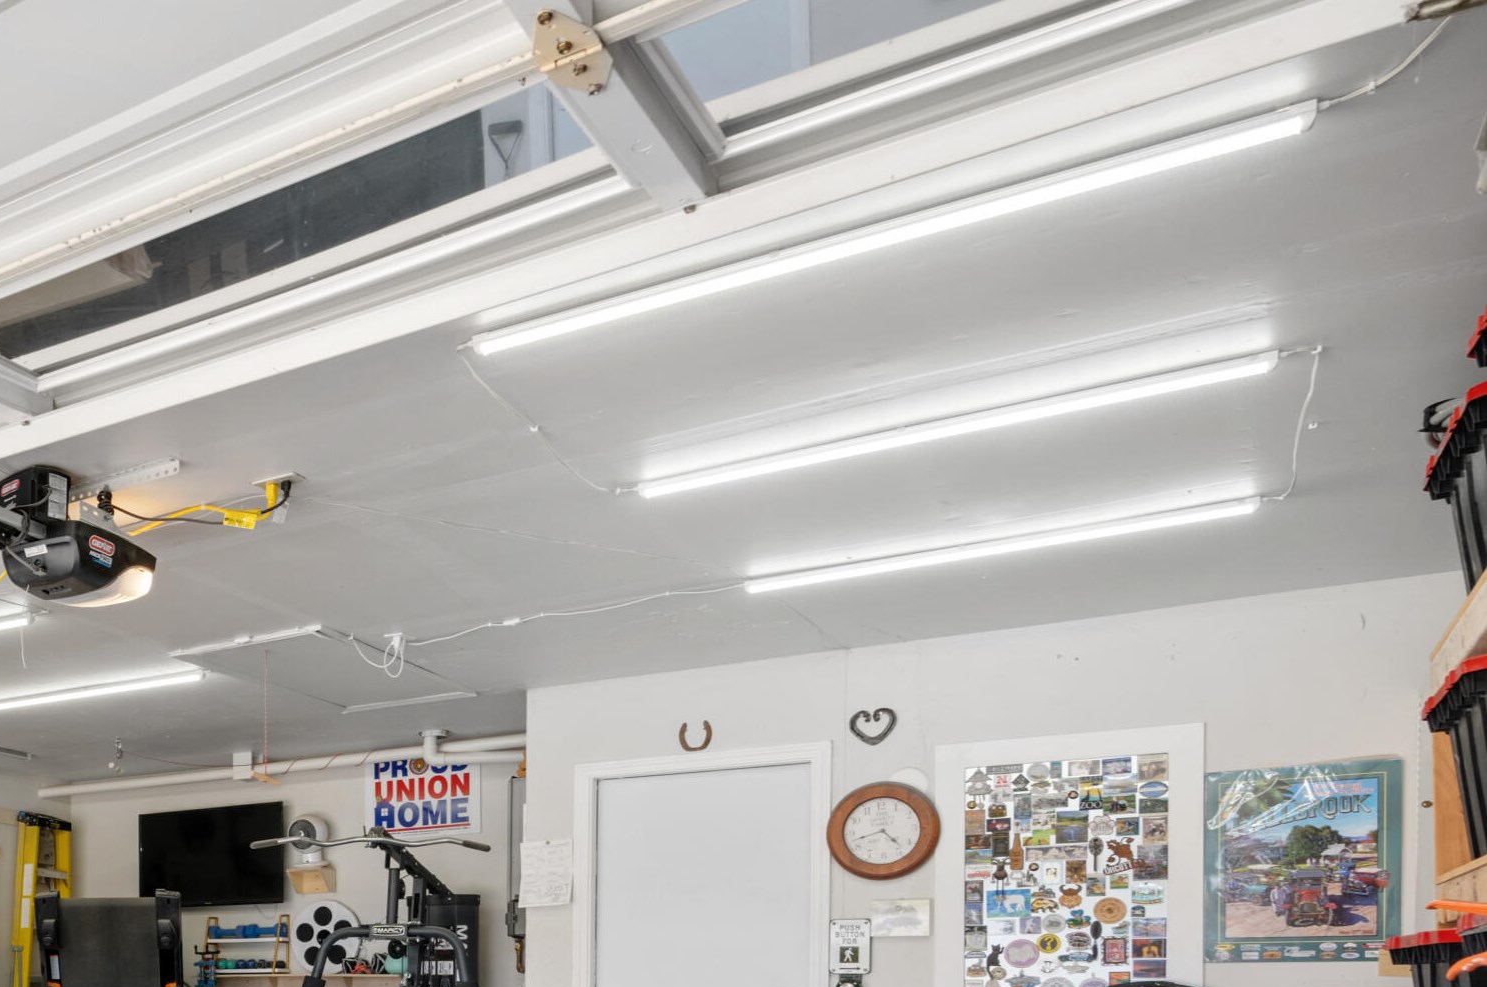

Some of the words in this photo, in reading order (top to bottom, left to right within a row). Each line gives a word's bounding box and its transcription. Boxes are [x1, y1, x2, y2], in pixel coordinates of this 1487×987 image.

[374, 772, 471, 803] UNION
[374, 797, 470, 829] HOME
[376, 927, 405, 935] MARCY
[842, 937, 858, 945] FOR
